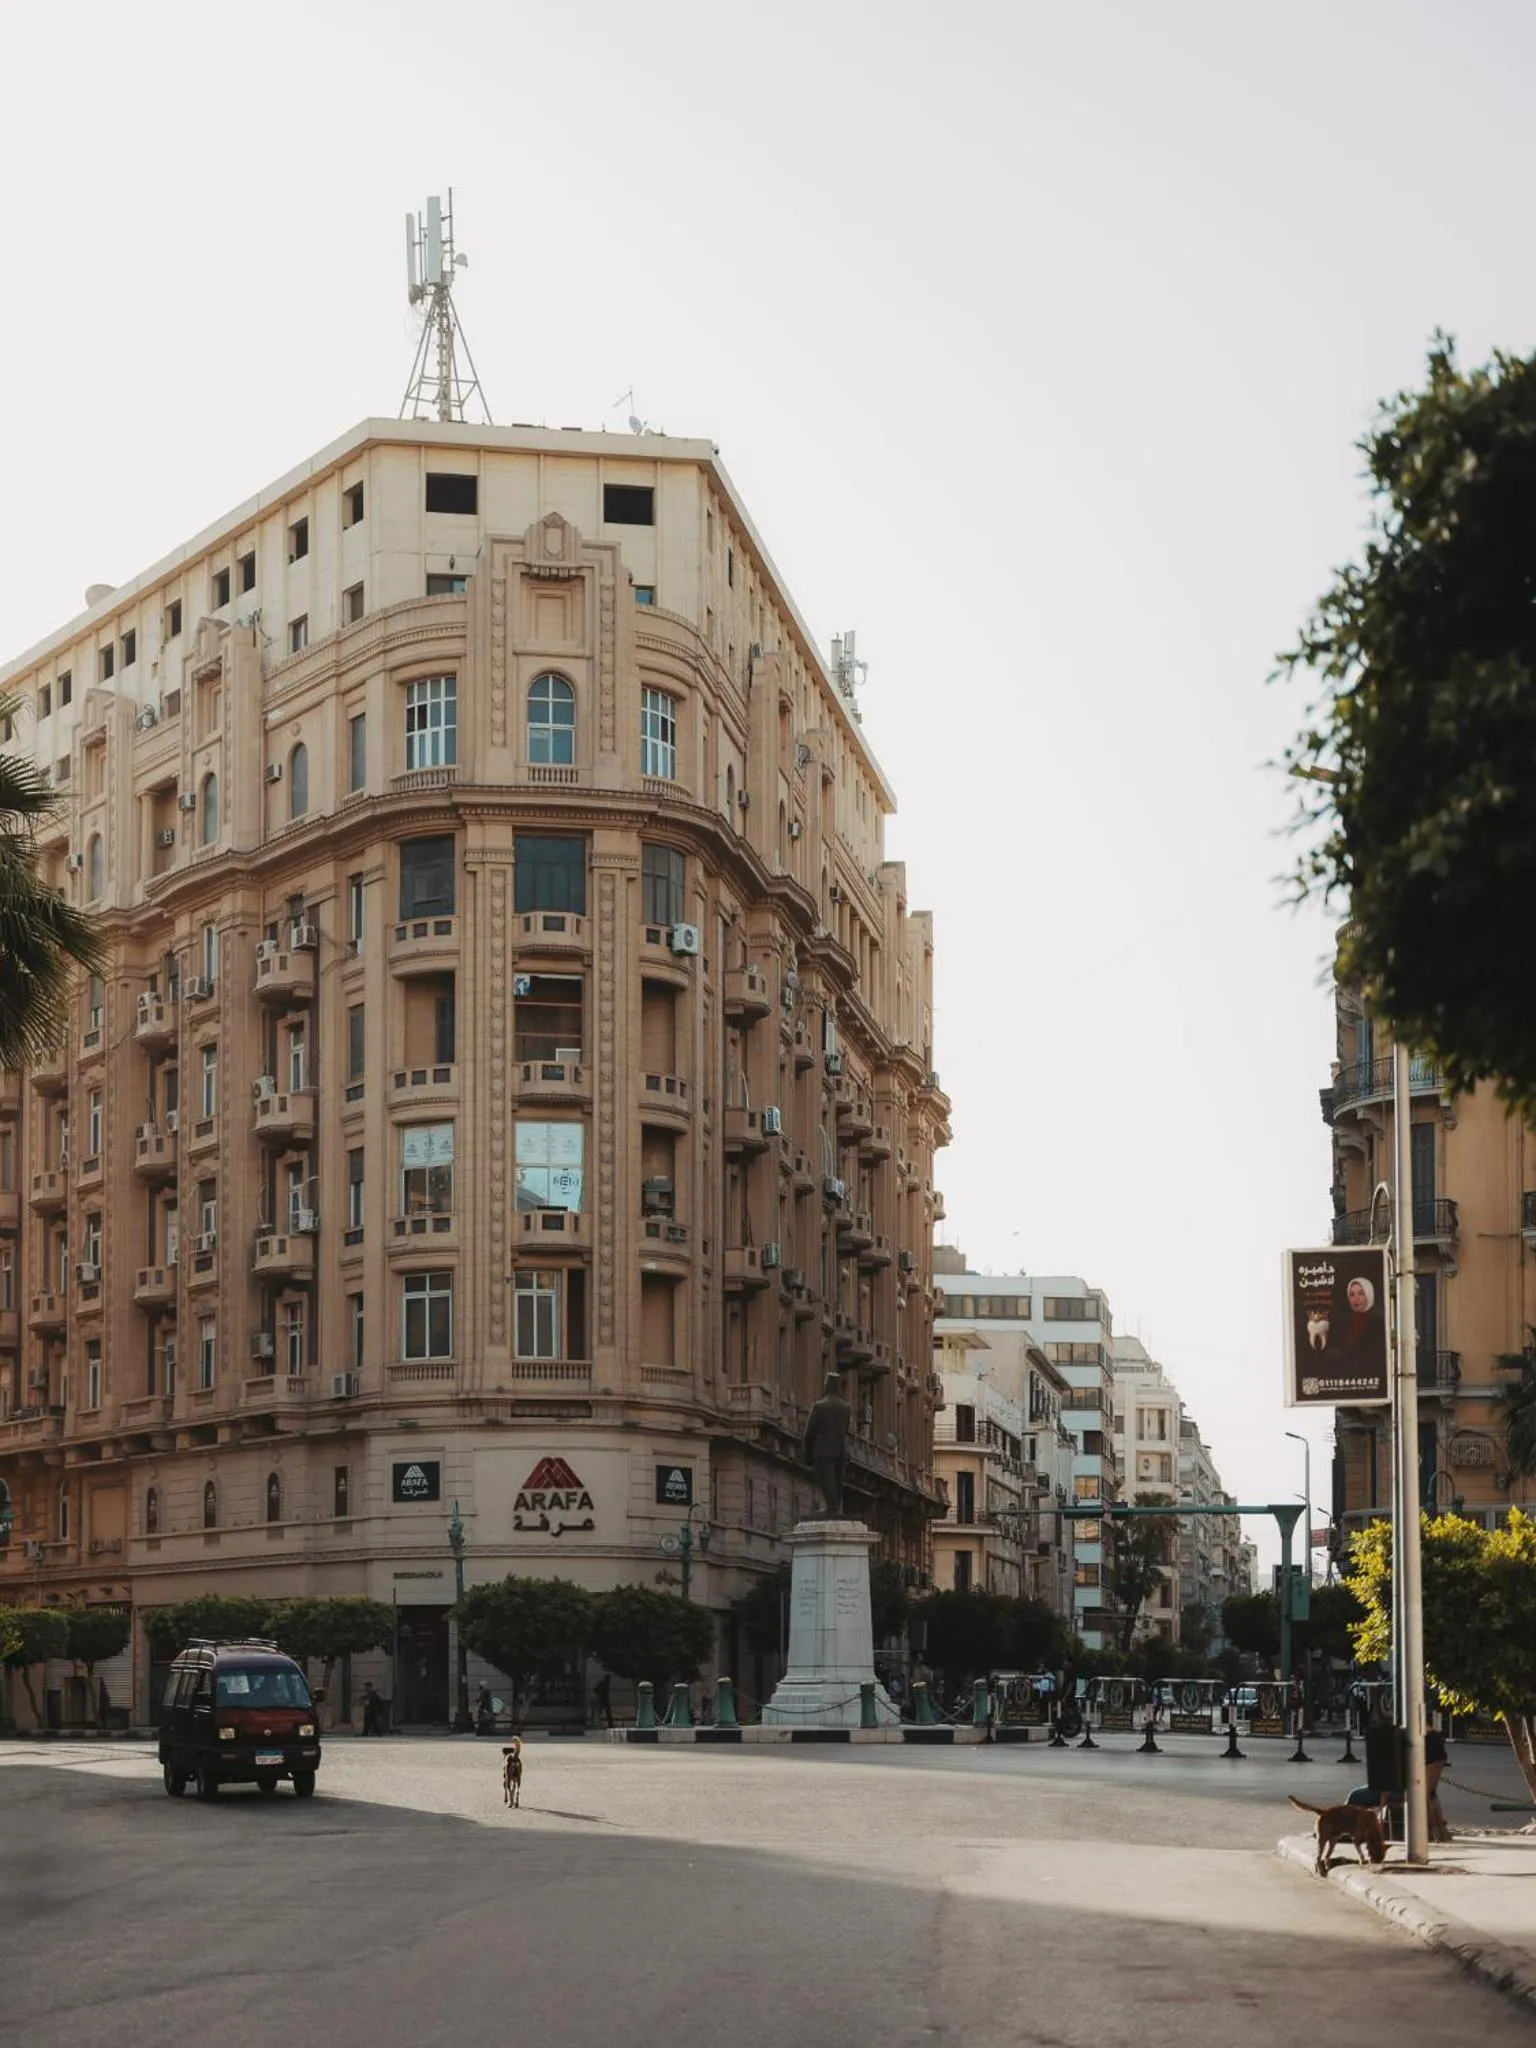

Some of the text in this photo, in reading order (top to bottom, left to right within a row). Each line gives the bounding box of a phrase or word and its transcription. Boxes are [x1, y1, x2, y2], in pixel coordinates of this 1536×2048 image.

[400, 1478, 429, 1487] ARAFA
[665, 1482, 688, 1491] ARAFA
[513, 1491, 594, 1511] ARAFA
[513, 1512, 595, 1537] عرفة
